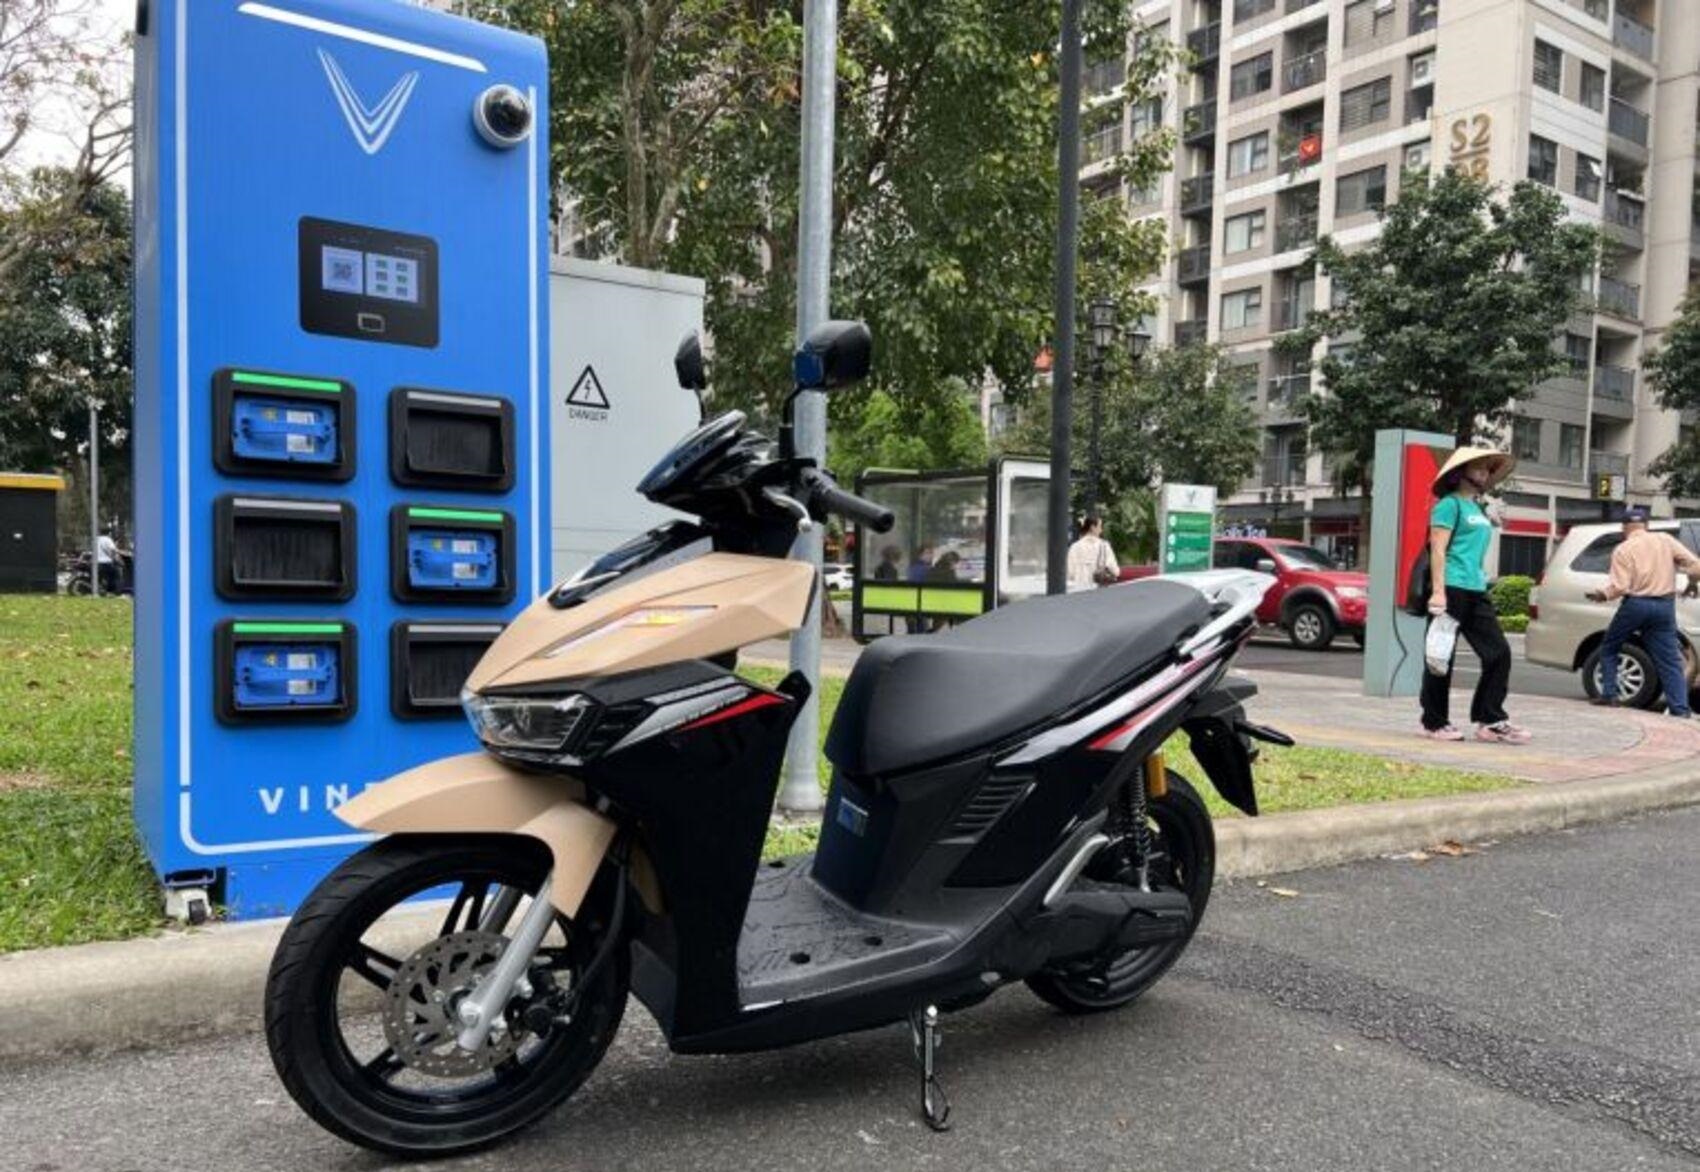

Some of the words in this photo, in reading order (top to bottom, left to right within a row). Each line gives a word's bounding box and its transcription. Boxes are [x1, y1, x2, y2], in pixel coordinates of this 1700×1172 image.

[1450, 113, 1491, 152] S2
[569, 407, 608, 421] DANGER
[258, 782, 373, 815] VIN
